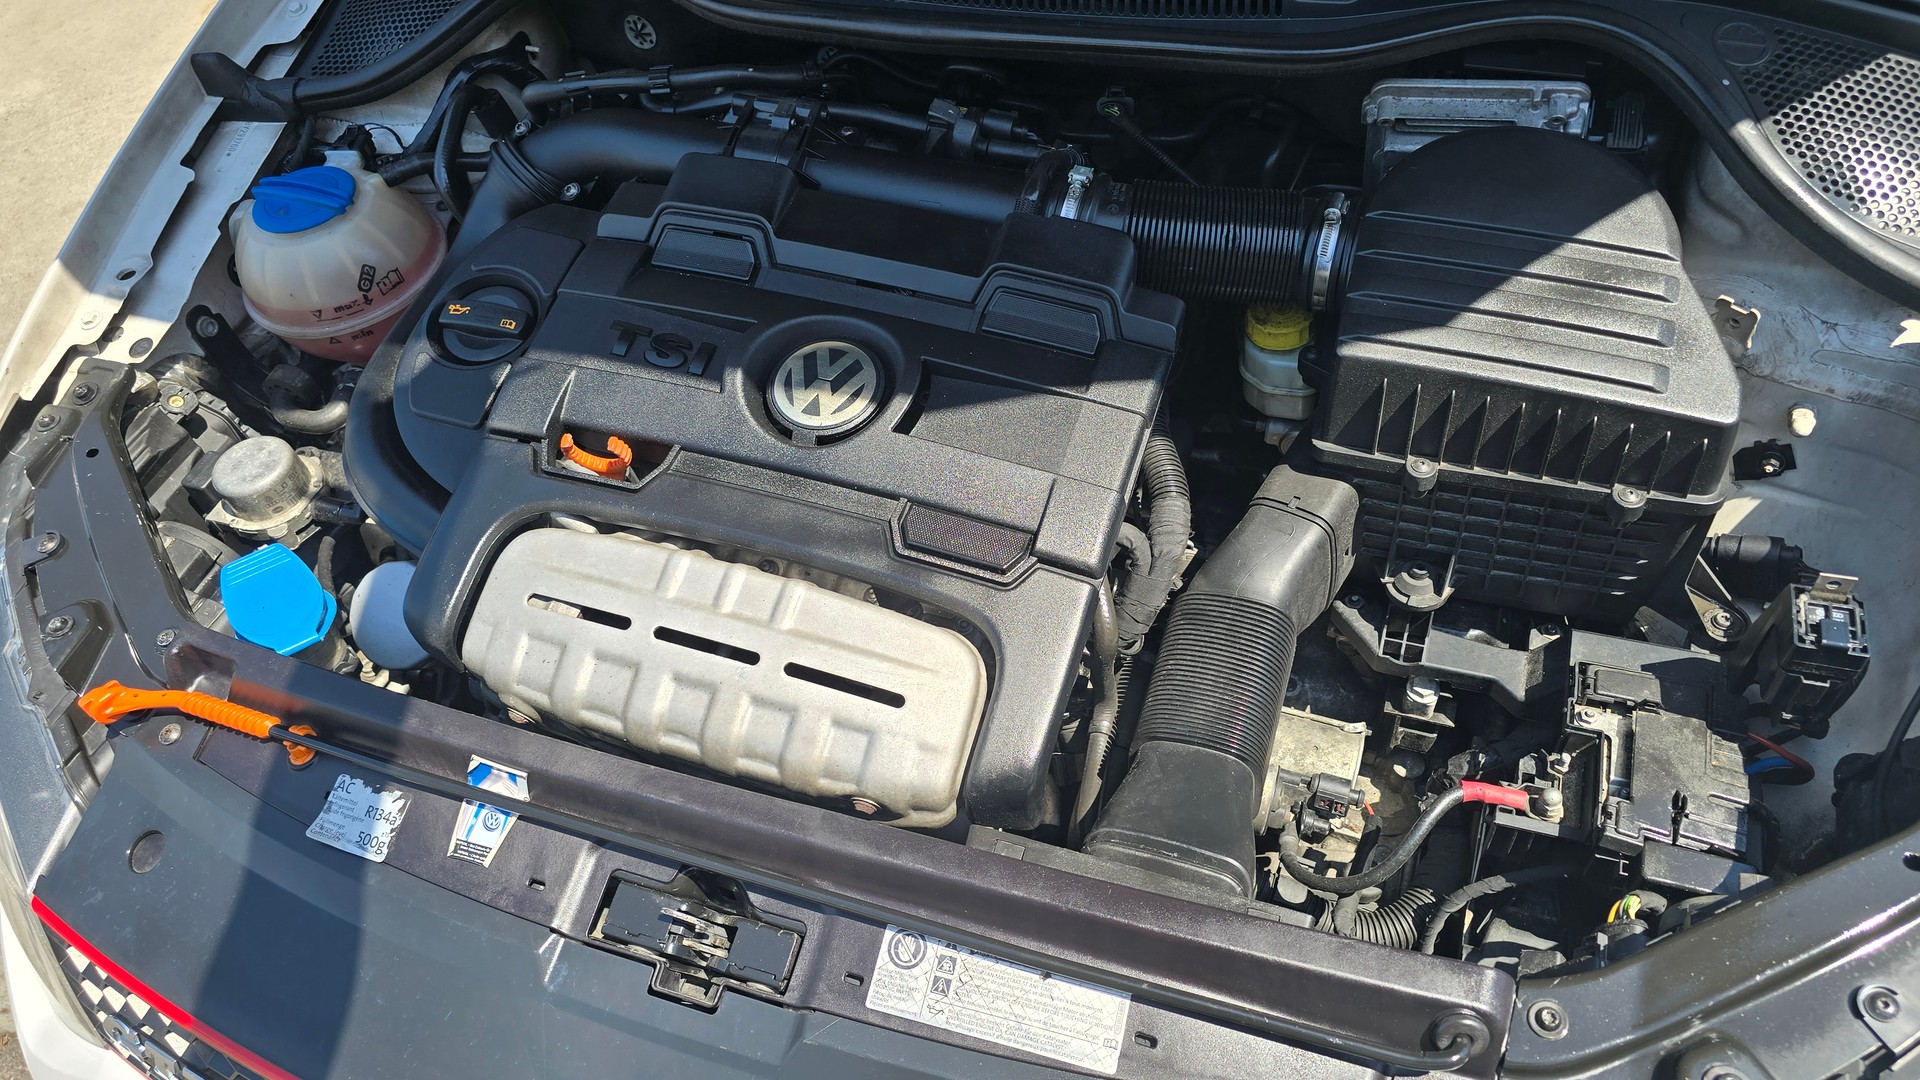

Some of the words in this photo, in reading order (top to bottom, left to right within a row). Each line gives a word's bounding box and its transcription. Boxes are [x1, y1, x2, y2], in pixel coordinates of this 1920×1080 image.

[361, 266, 374, 290] G12
[351, 329, 374, 340] min
[609, 319, 717, 376] TSI
[335, 779, 355, 795] AC
[364, 805, 397, 826] R134a
[355, 831, 387, 855] 500g
